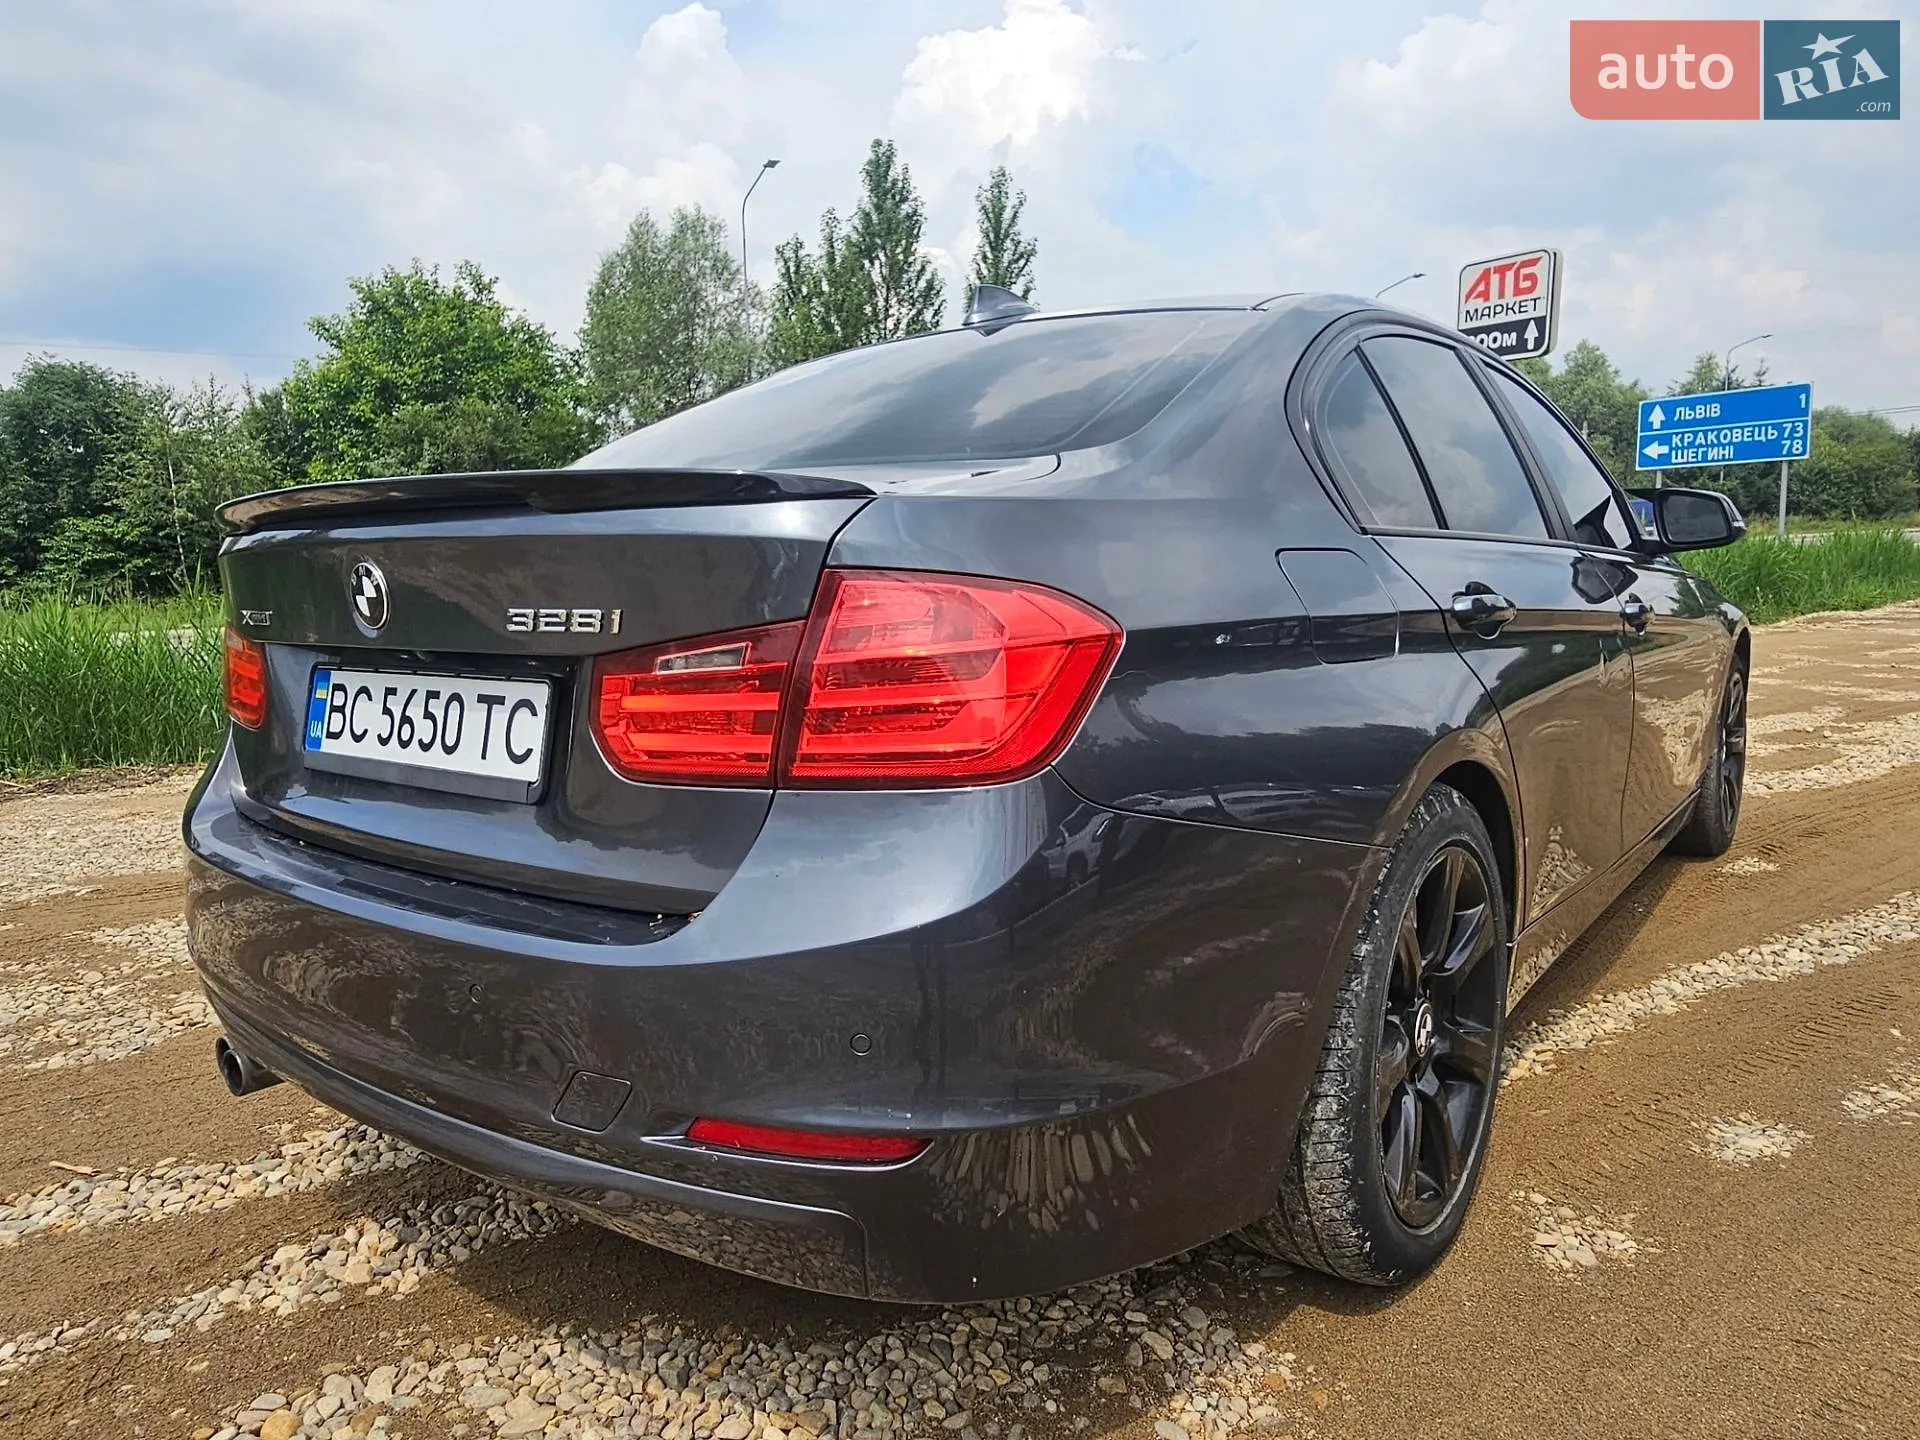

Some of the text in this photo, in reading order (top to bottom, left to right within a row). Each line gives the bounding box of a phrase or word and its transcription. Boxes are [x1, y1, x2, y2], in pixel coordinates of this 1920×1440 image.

[1464, 256, 1543, 304] АТБ
[1465, 297, 1541, 323] МАРКЕТ
[1674, 393, 1806, 421] ЛЬВІВ 1
[1672, 422, 1804, 447] КРАКОВЕЦЬ 73
[1671, 439, 1803, 463] ШЕГИНІ 78
[310, 720, 322, 738] UA
[326, 683, 538, 764] BC 5650 TC
